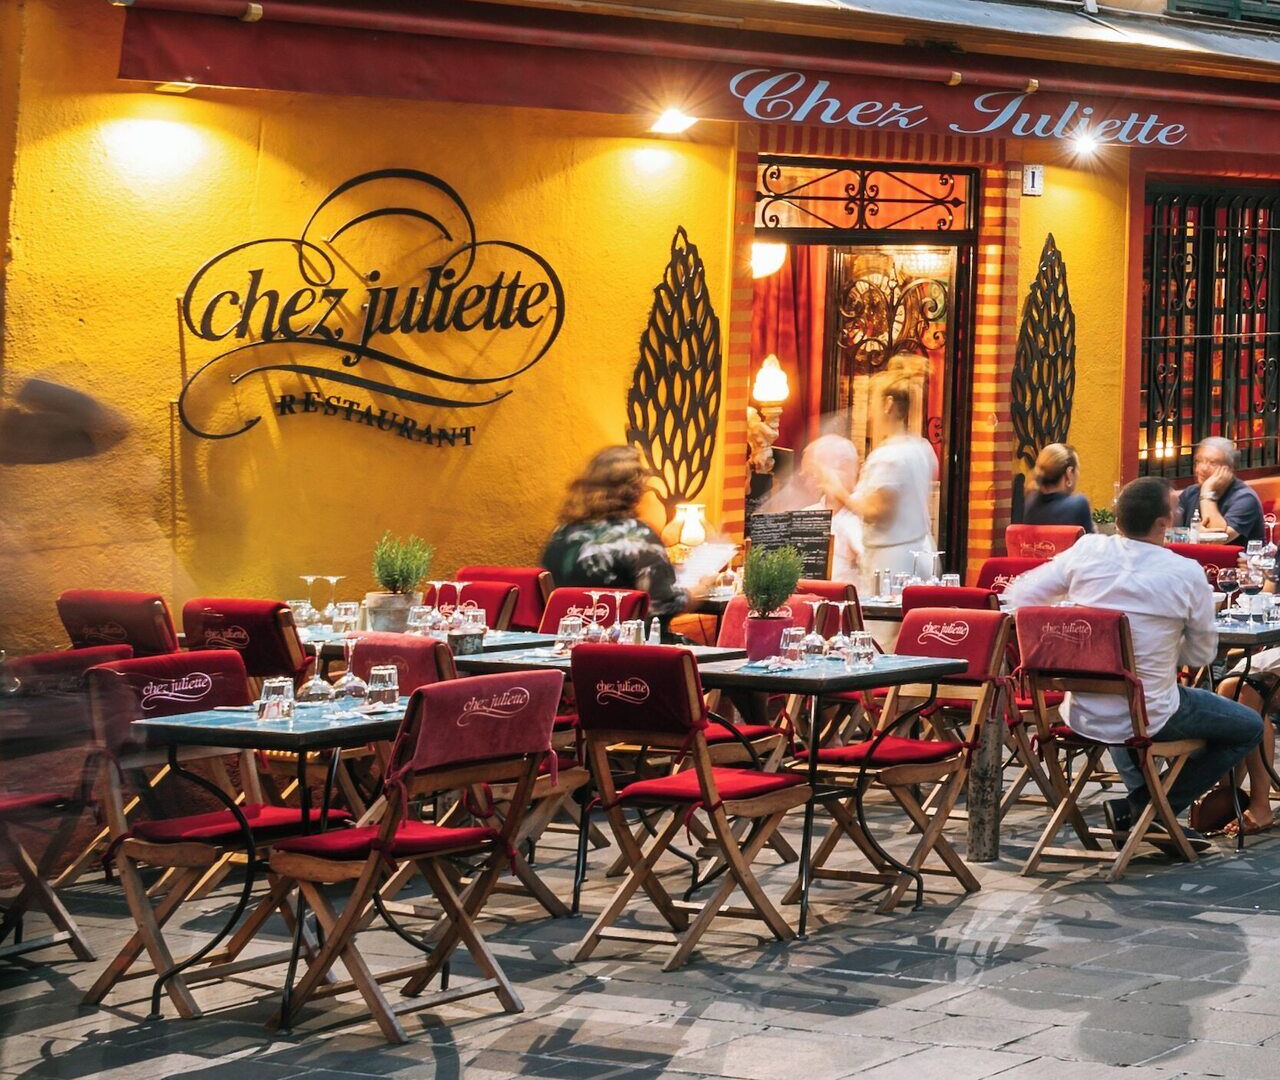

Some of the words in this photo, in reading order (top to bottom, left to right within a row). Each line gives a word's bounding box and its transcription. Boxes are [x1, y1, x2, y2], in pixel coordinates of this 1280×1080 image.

[728, 68, 928, 131] Chez
[948, 90, 1189, 146] Juliette
[201, 267, 349, 341] chez
[343, 265, 549, 366] juliette
[276, 390, 477, 447] RESTAURANT
[143, 682, 168, 695] chez
[170, 678, 208, 696] juliette
[490, 691, 527, 711] juliette
[616, 681, 647, 696] juliette
